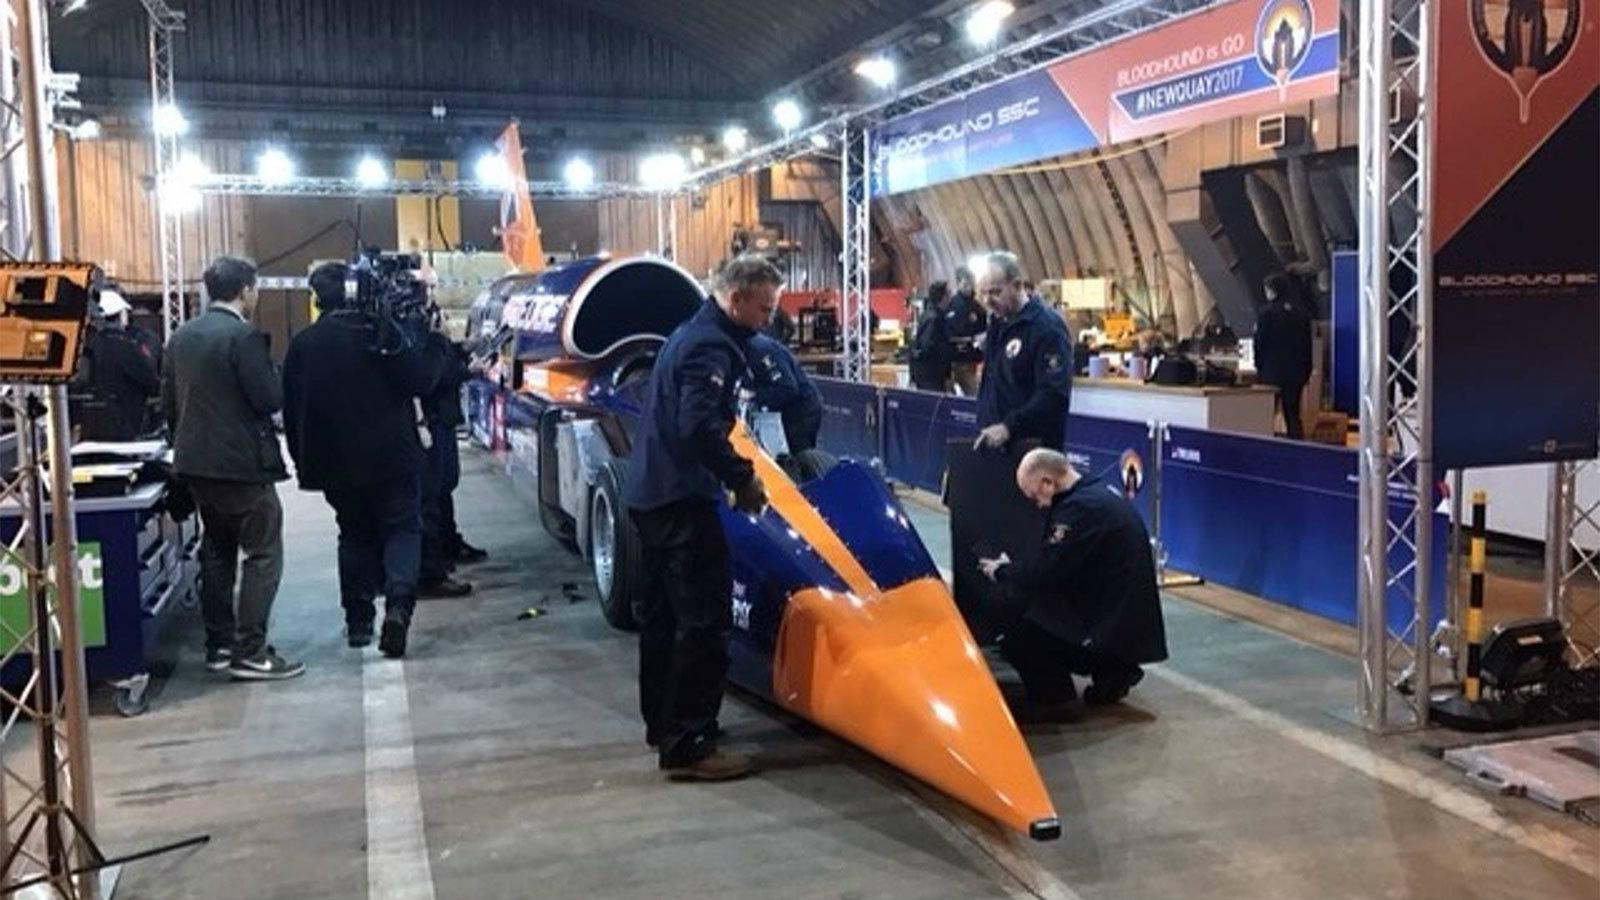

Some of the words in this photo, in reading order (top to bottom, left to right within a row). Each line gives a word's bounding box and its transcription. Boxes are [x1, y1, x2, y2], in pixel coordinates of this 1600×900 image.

[1117, 44, 1204, 87] BLOODHOUND
[1222, 33, 1245, 55] GO
[1438, 274, 1562, 286] BLOODHOUND
